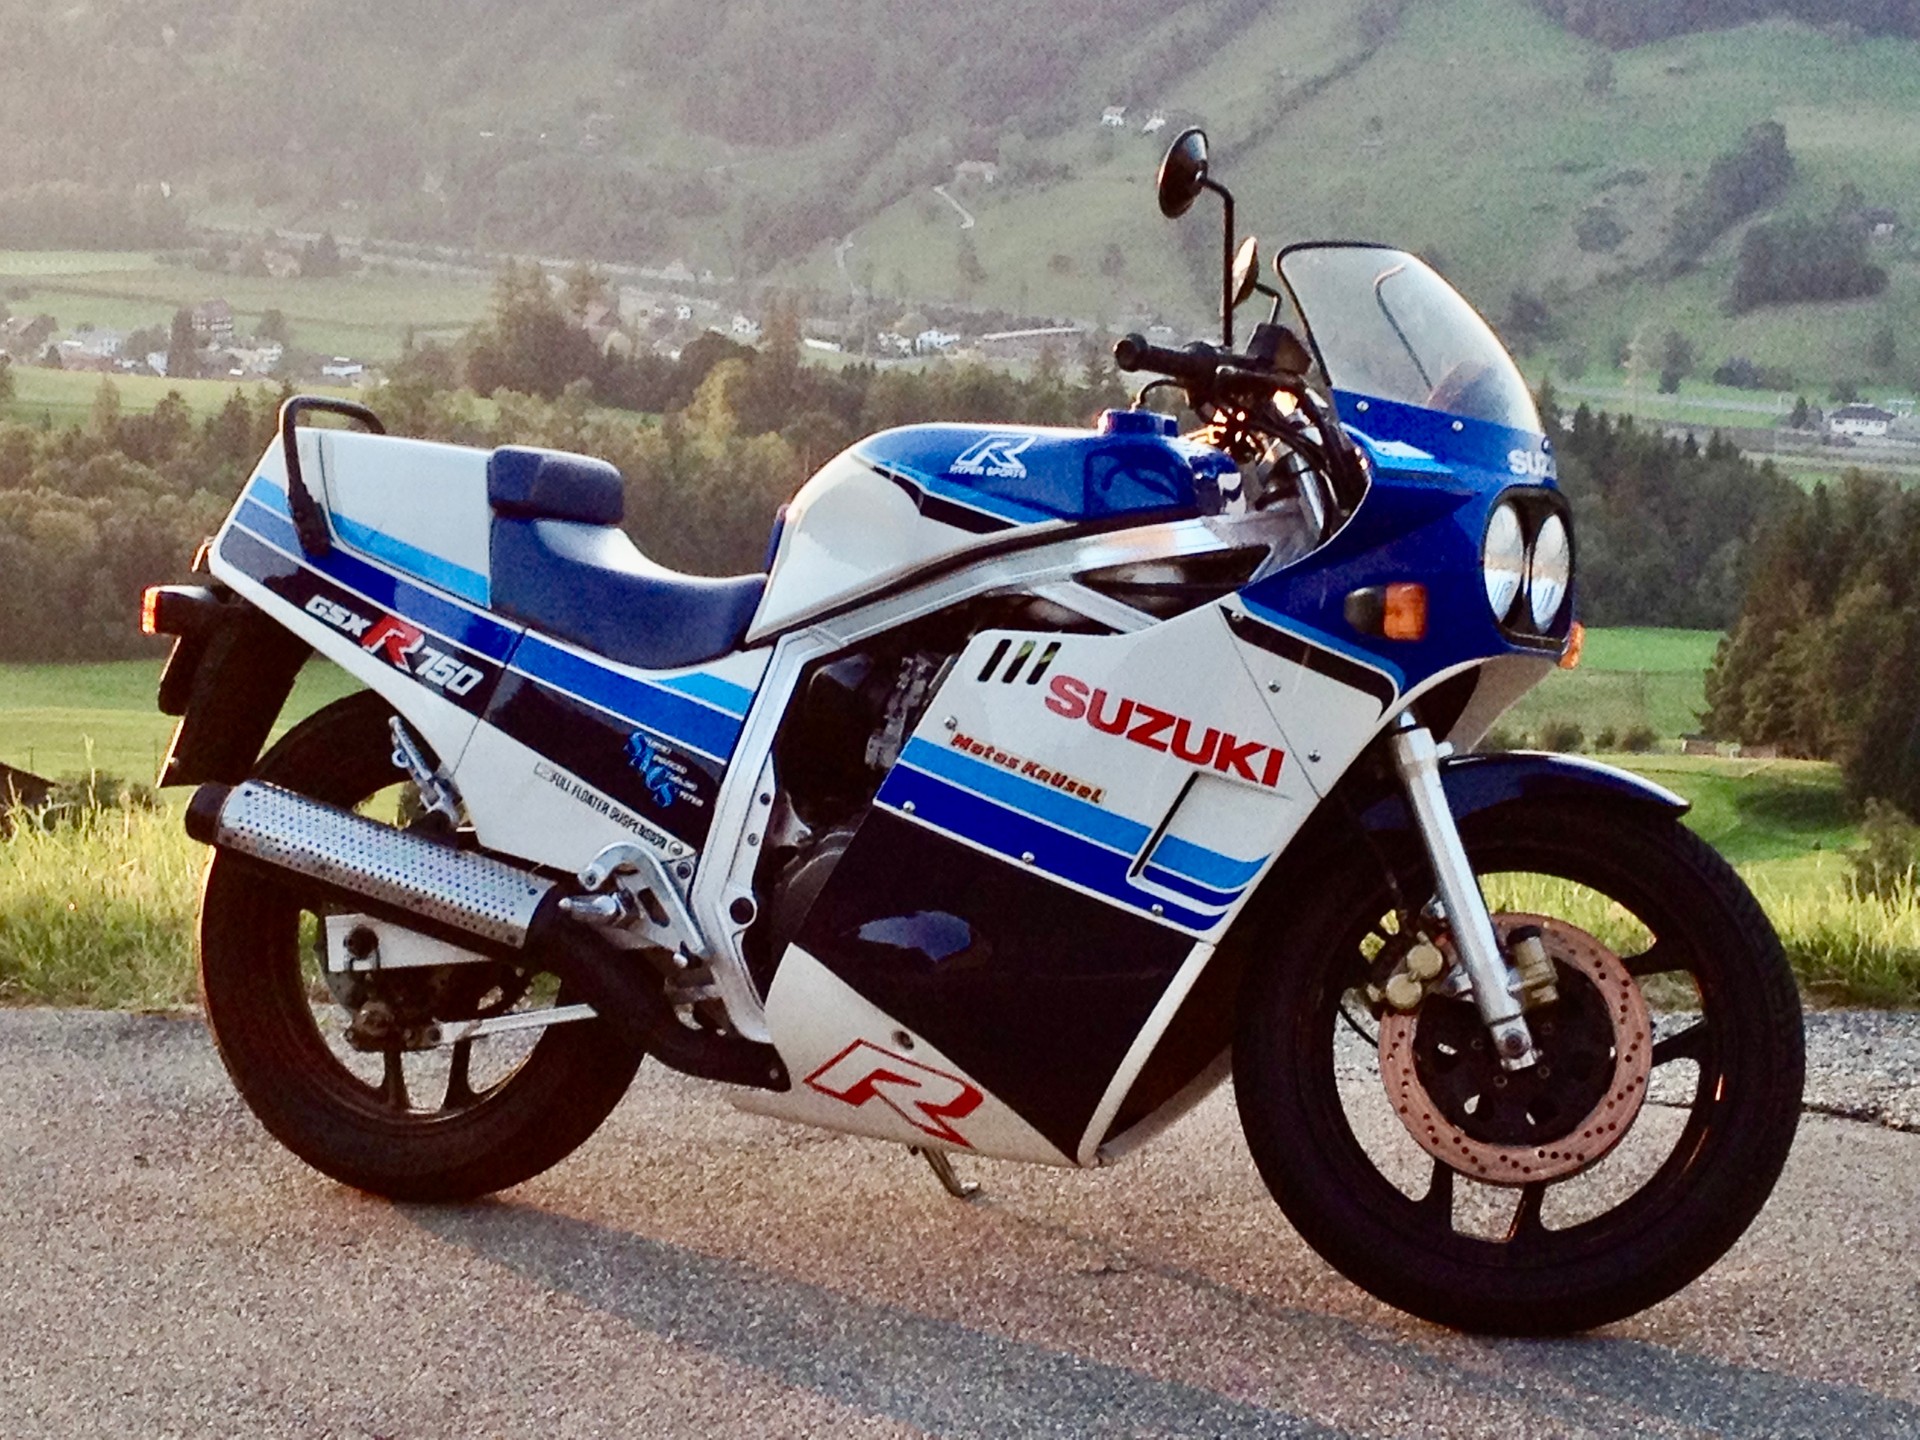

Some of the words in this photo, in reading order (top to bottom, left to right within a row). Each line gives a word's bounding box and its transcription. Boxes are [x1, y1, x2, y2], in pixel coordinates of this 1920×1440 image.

[950, 732, 1021, 771] Motos
[1044, 674, 1286, 789] SUZUKI
[570, 784, 611, 817] FLOATER
[608, 804, 668, 850] SUSPENSION
